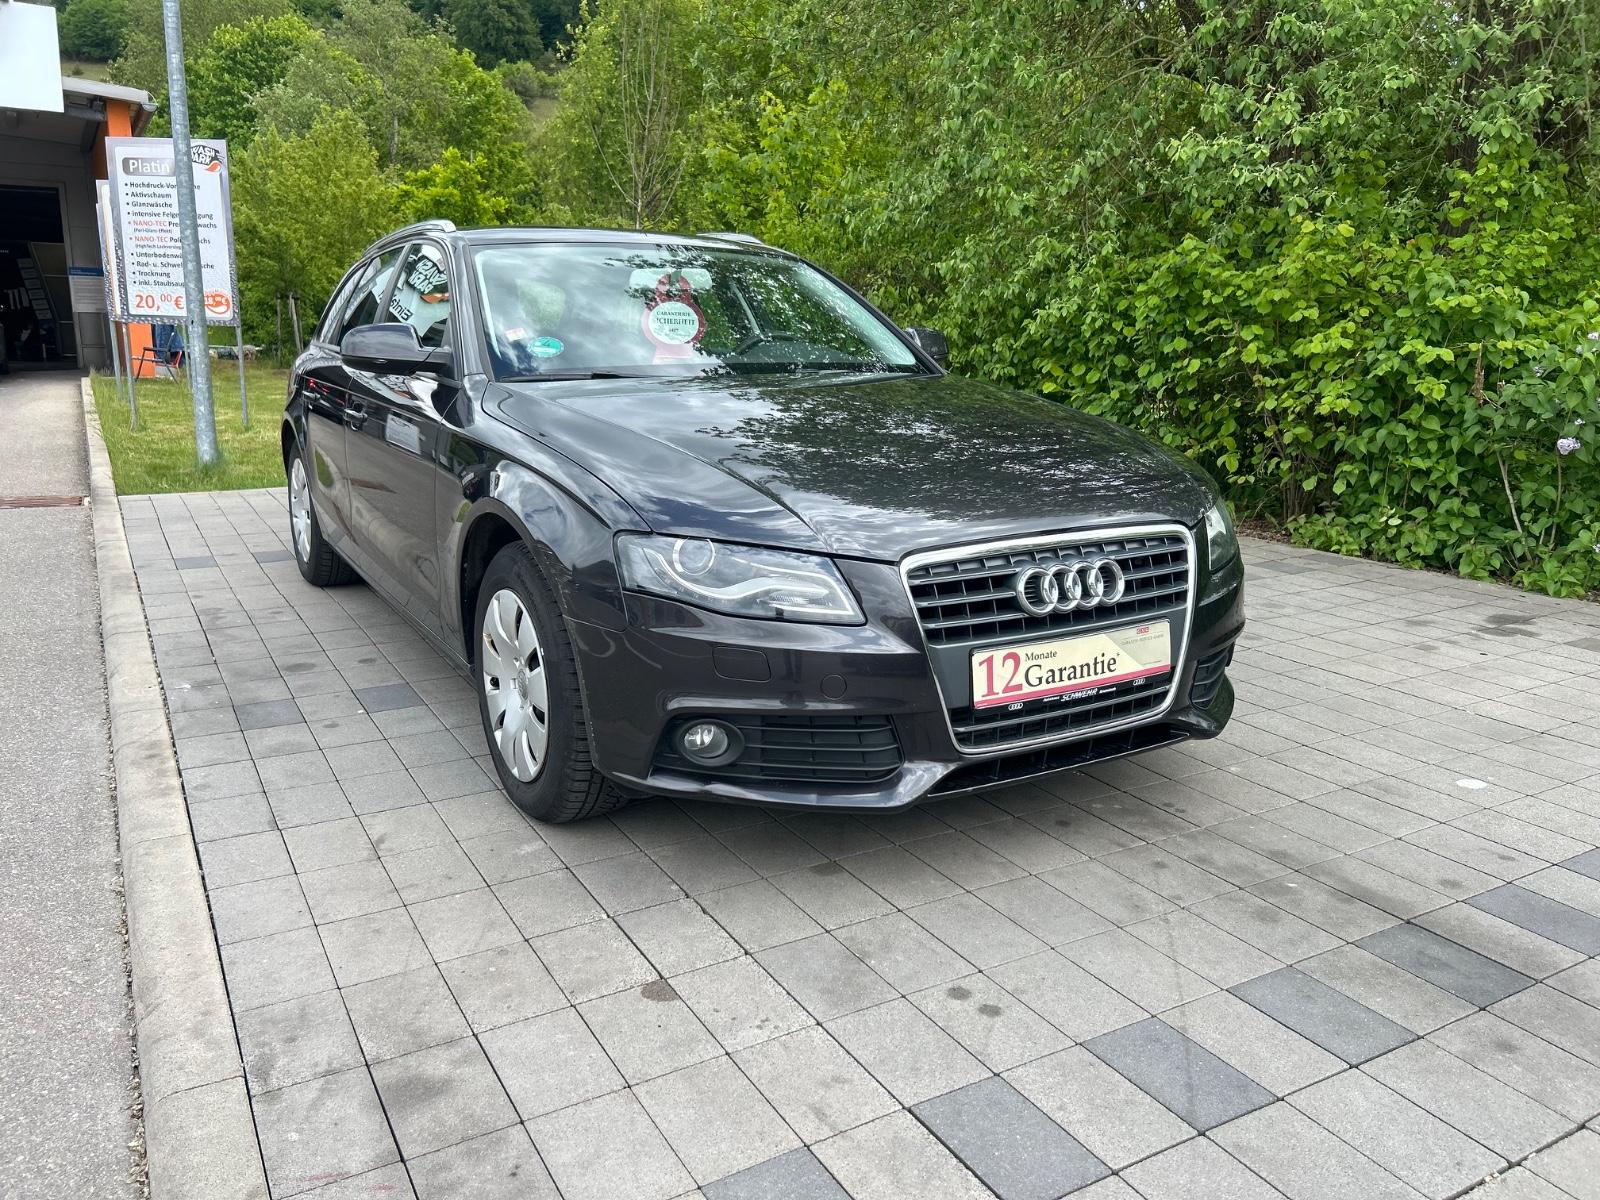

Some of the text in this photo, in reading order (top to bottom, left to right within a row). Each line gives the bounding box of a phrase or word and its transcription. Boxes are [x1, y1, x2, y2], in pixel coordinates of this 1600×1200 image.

[129, 159, 170, 173] Platin
[138, 270, 171, 278] Trocknung
[978, 650, 1058, 698] 12 Monate
